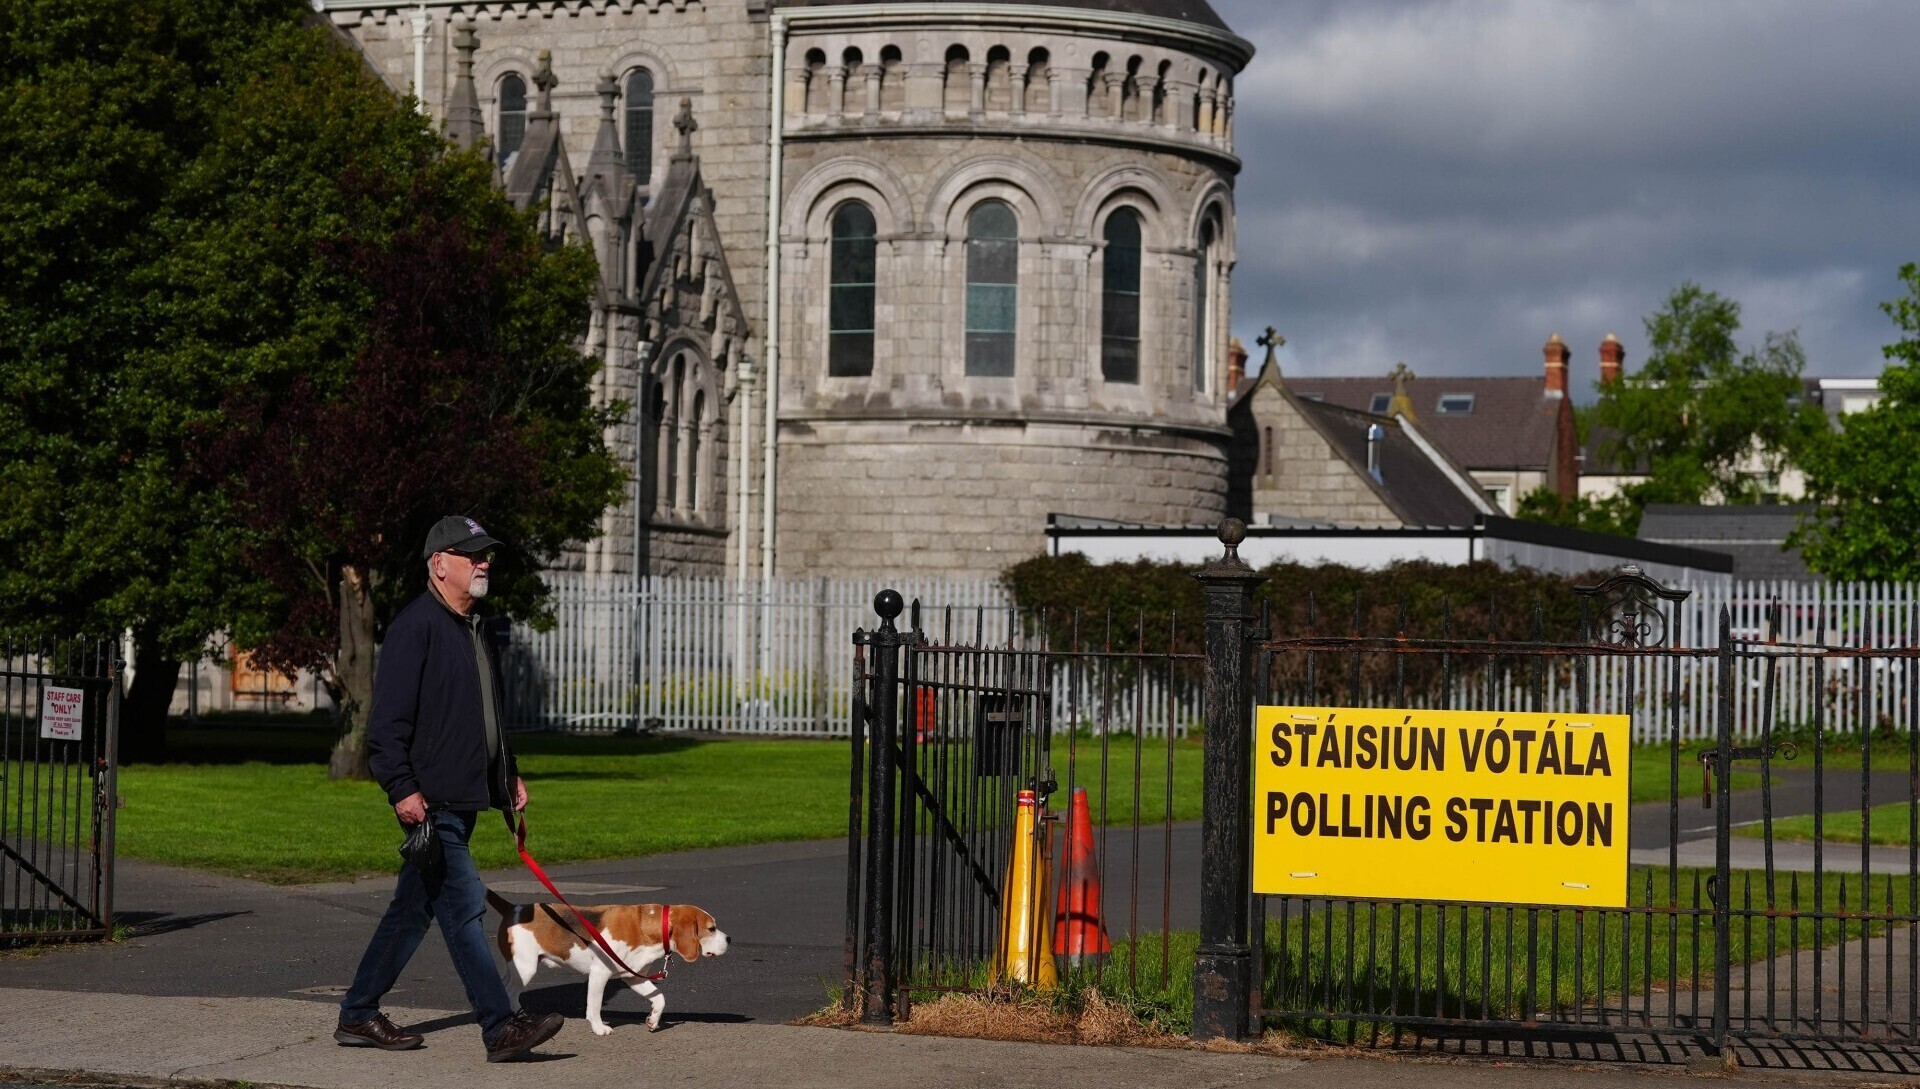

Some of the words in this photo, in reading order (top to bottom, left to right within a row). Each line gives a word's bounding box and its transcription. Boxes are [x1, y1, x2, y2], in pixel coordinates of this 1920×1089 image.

[46, 691, 65, 701] STAFF
[66, 693, 81, 703] CARS
[53, 704, 72, 714] ONLY
[1270, 714, 1445, 772] STÁISIÚN
[1459, 718, 1612, 777] VÓTÁLA
[1266, 791, 1431, 840] POLLING
[1444, 797, 1613, 847] STATION
